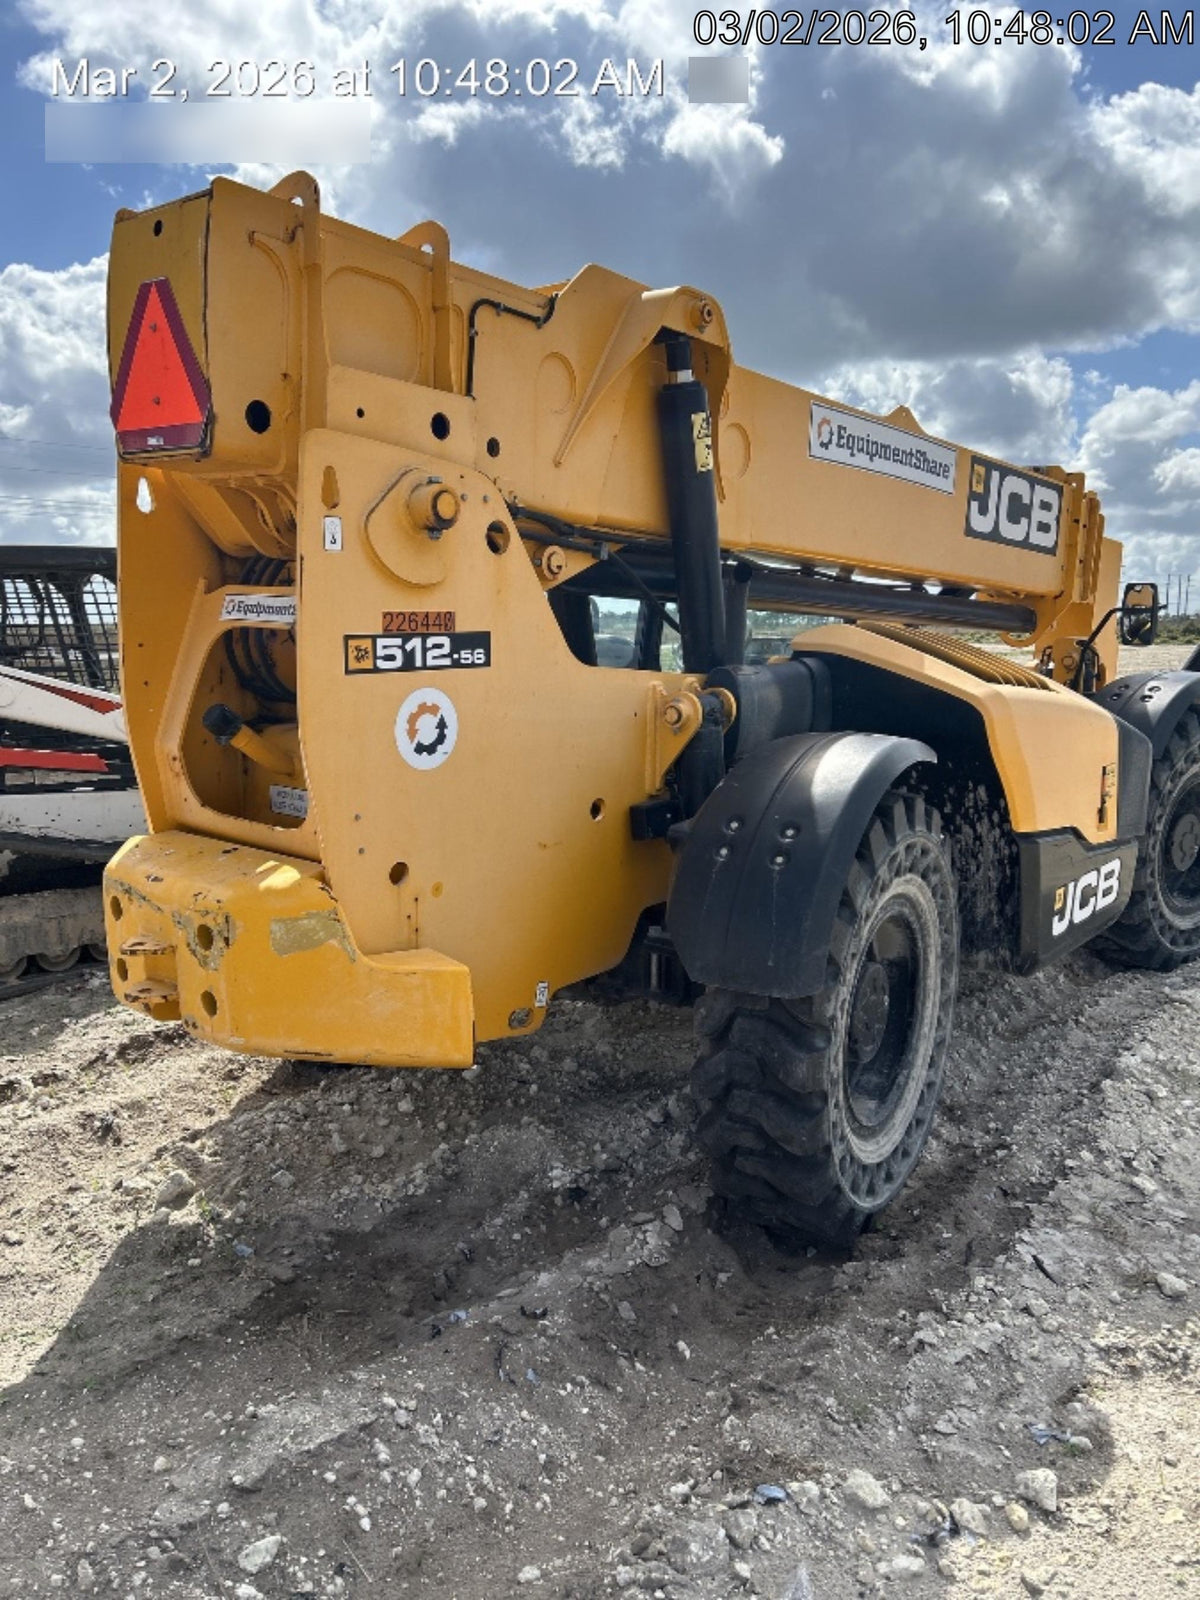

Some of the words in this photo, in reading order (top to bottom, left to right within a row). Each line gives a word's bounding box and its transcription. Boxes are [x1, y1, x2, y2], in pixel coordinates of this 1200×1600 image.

[835, 424, 951, 479] EquipmentShare
[969, 469, 1059, 549] JCB
[1052, 858, 1121, 936] JCB
